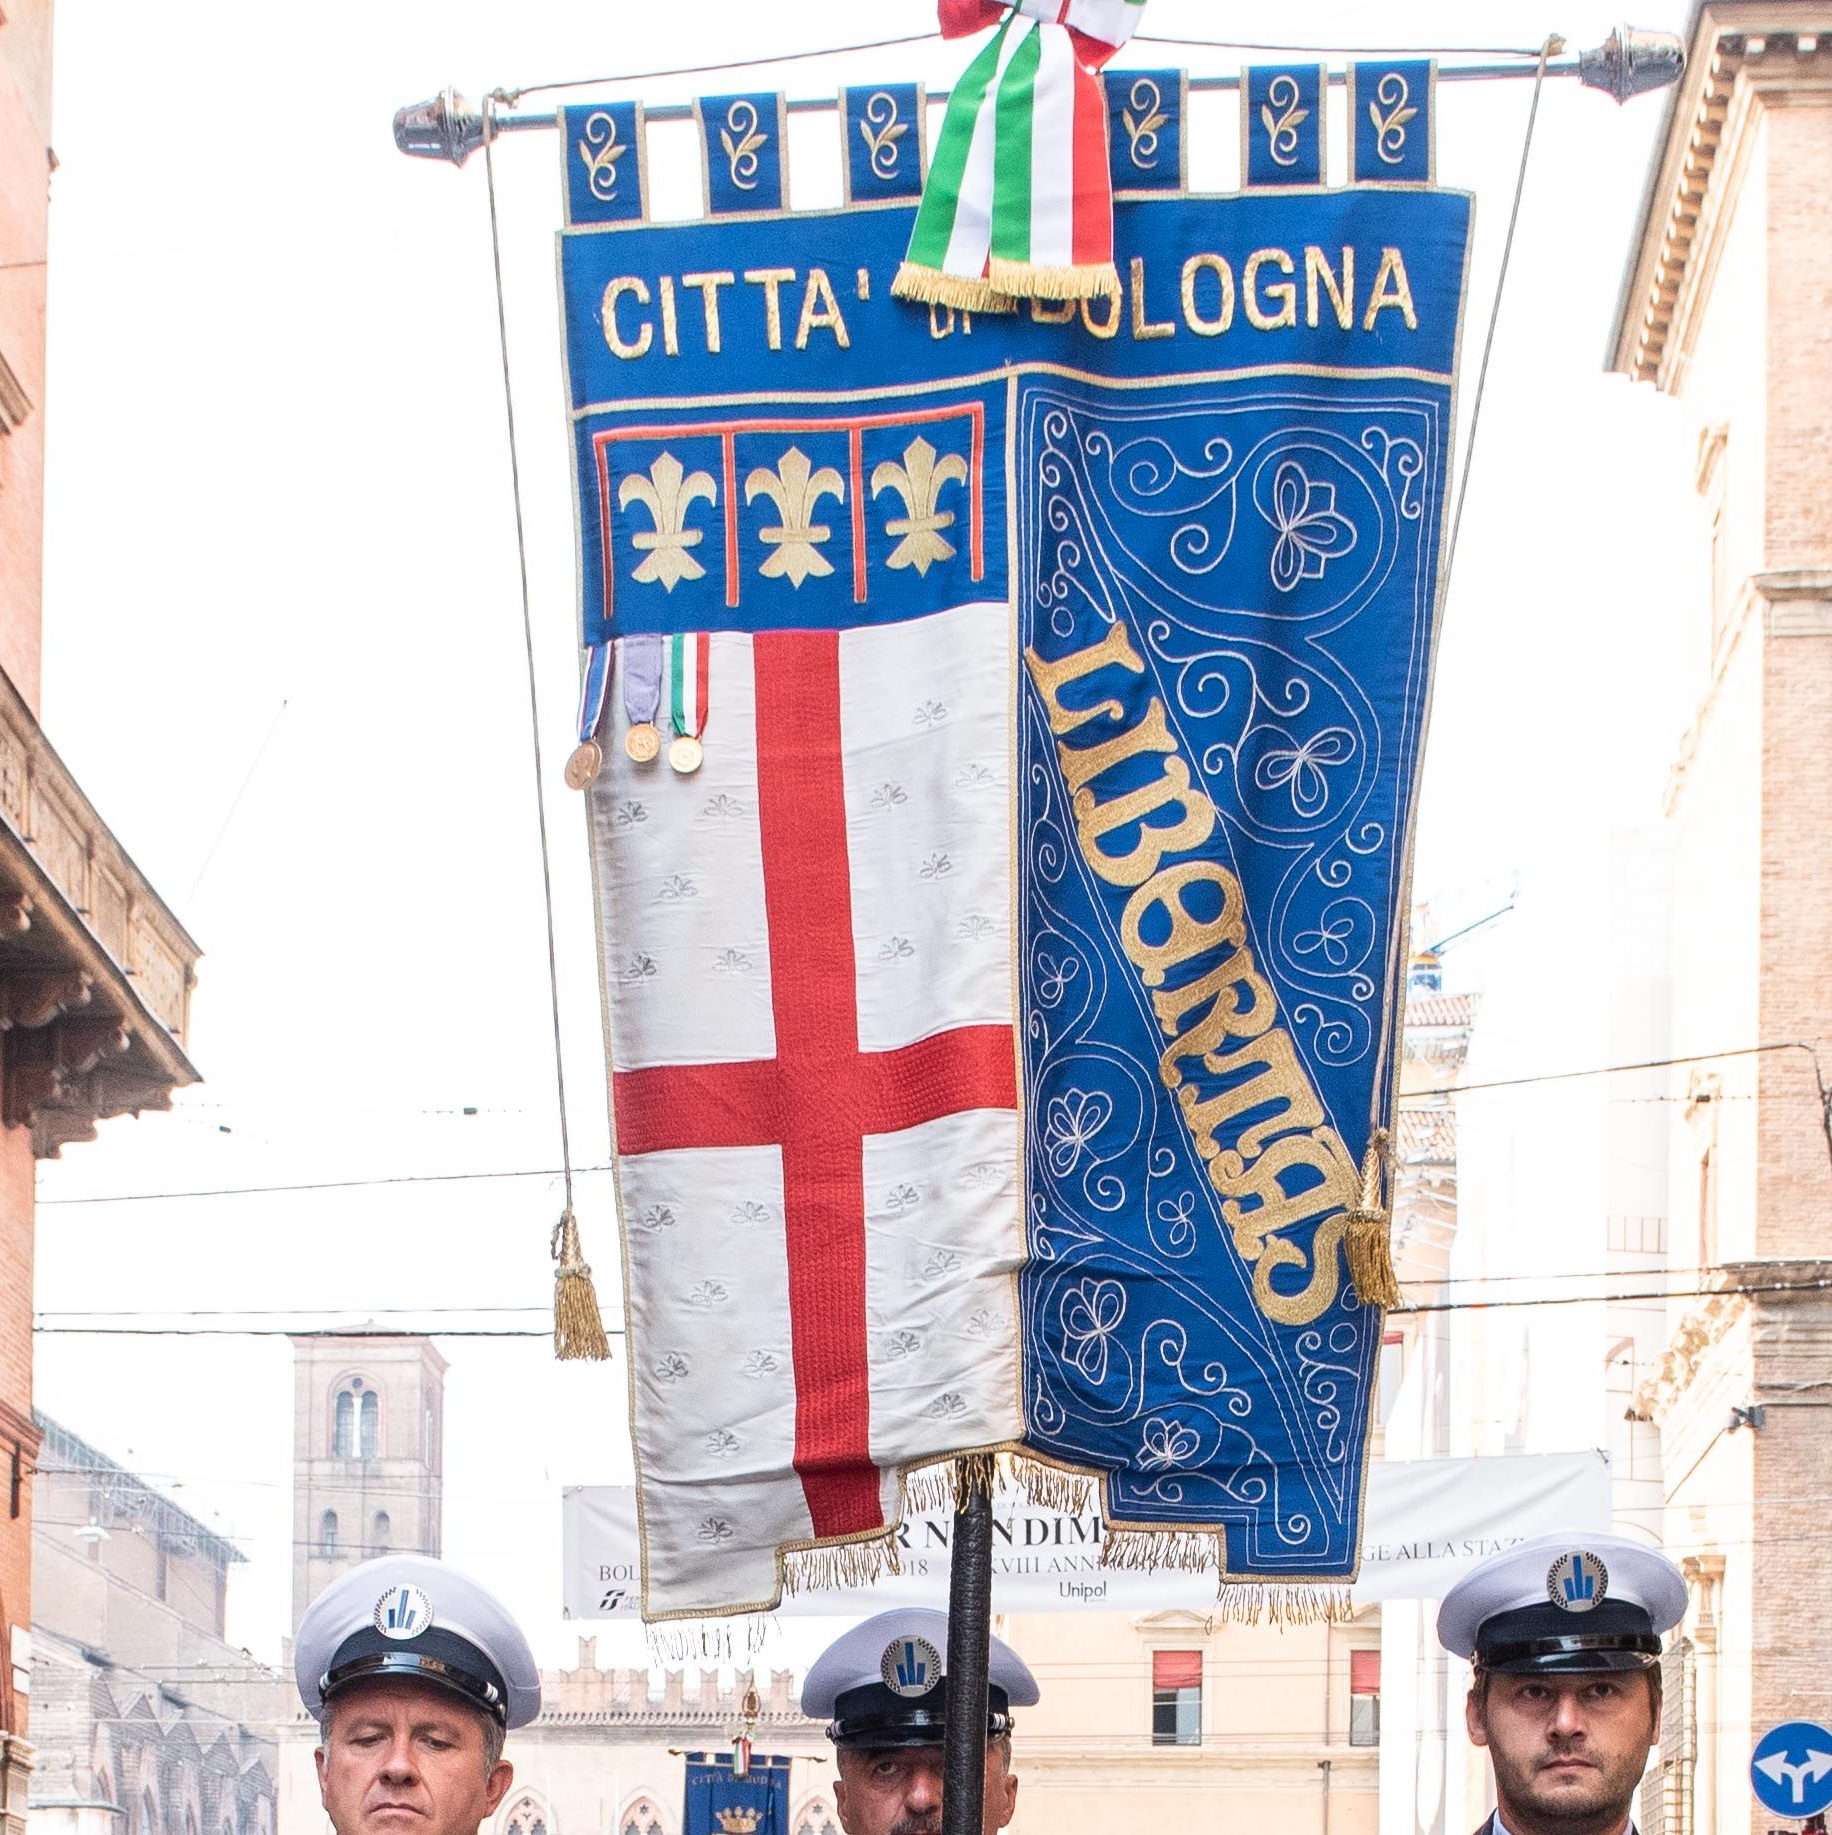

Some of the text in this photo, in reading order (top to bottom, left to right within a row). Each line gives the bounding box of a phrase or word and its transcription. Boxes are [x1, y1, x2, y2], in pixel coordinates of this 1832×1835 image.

[601, 268, 870, 360] CITTA'
[1396, 1541, 1456, 1561] ALLA
[1059, 1581, 1107, 1602] Unipol
